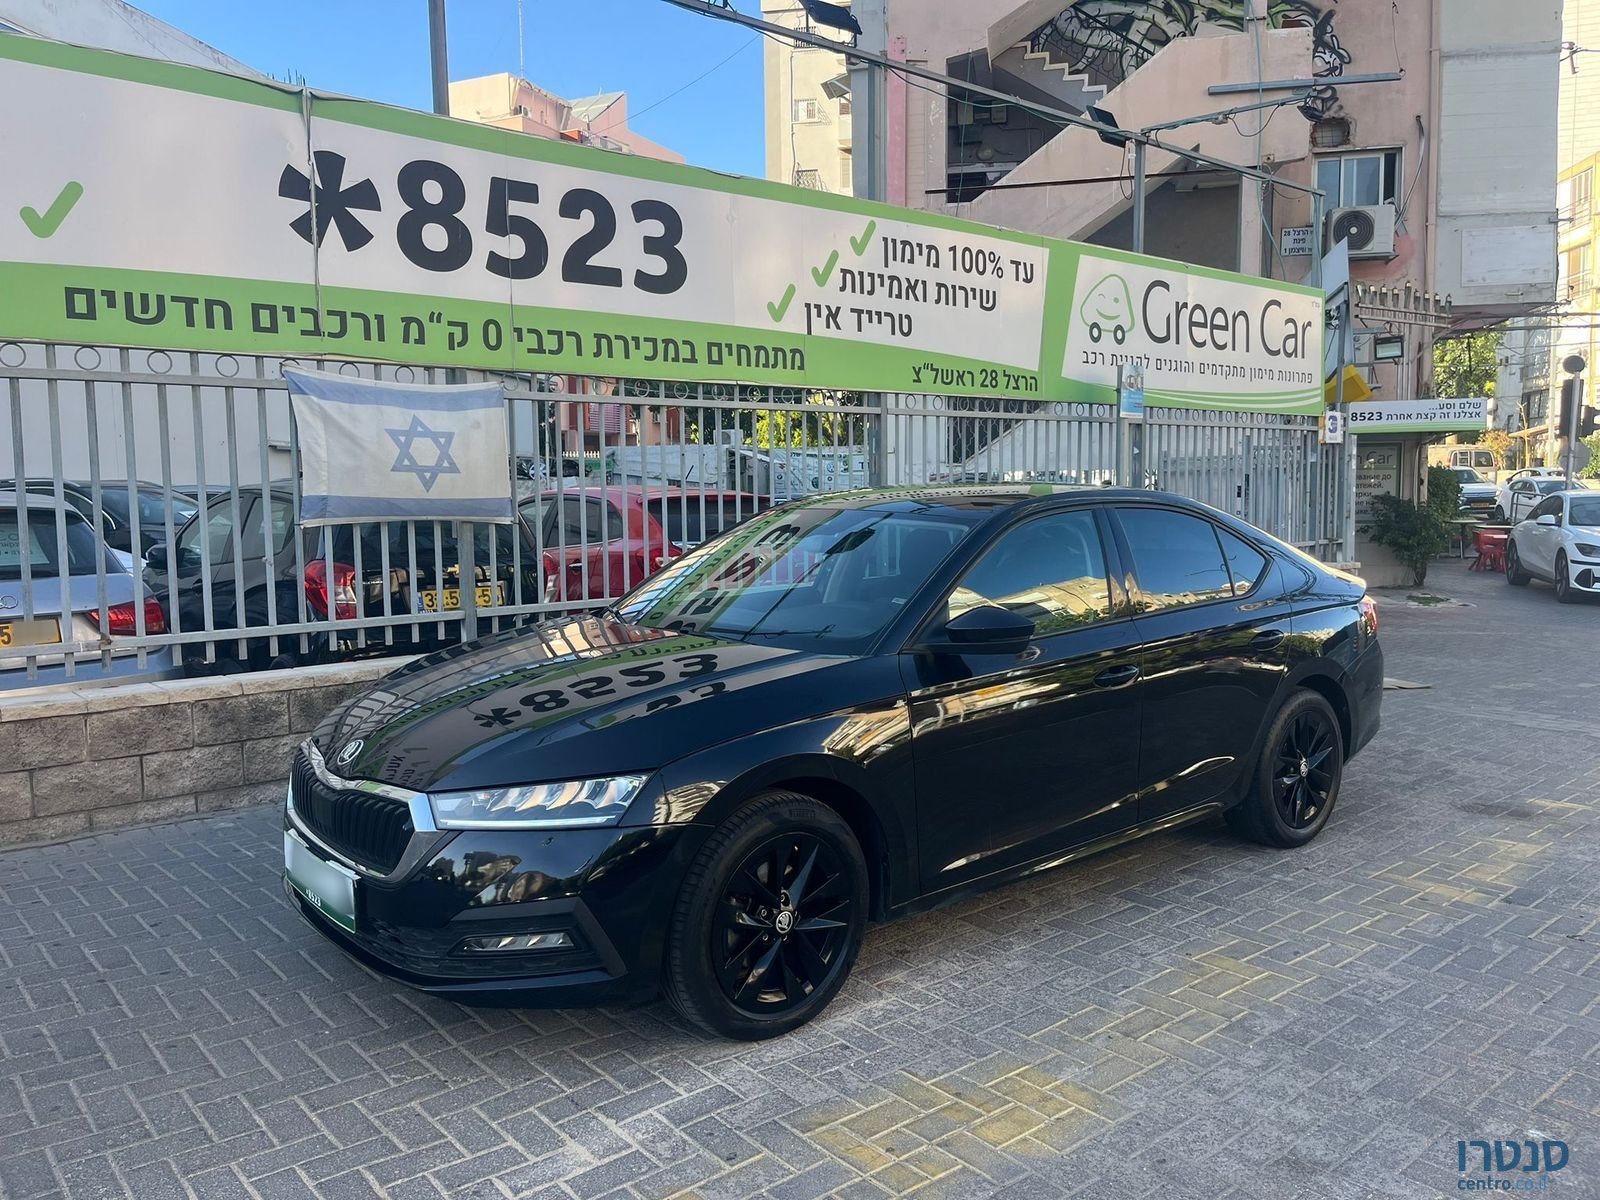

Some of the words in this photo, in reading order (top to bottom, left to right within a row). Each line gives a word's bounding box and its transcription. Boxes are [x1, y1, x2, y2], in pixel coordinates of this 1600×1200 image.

[882, 236, 940, 269] מימון
[948, 245, 1004, 279] 100%
[1009, 259, 1034, 284] עד
[839, 268, 927, 303] ואמינות
[935, 282, 997, 311] שירות
[64, 286, 233, 331] חדשים
[804, 302, 842, 335] אין
[1142, 279, 1250, 352] Green
[1260, 299, 1312, 359] Car
[251, 302, 385, 343] ורכבים
[481, 318, 503, 351] 0
[850, 308, 913, 337] טרייד
[513, 326, 582, 357] רכבי
[593, 332, 698, 363] במכירת
[707, 341, 805, 371] מתמחים
[1082, 351, 1105, 365] רכב
[1156, 358, 1194, 373] והוגנים
[980, 368, 998, 388] 28
[1003, 369, 1038, 392] הרצל
[1199, 363, 1245, 380] מתקדמים
[1249, 367, 1274, 382] מימון
[1278, 370, 1312, 384] פתרונות
[1350, 412, 1383, 421] 8523
[1386, 412, 1413, 421] אחרת
[1416, 412, 1436, 421] קצת
[1453, 411, 1482, 419] אצלנו
[1459, 401, 1482, 410] שלם
[1366, 451, 1392, 464] Car
